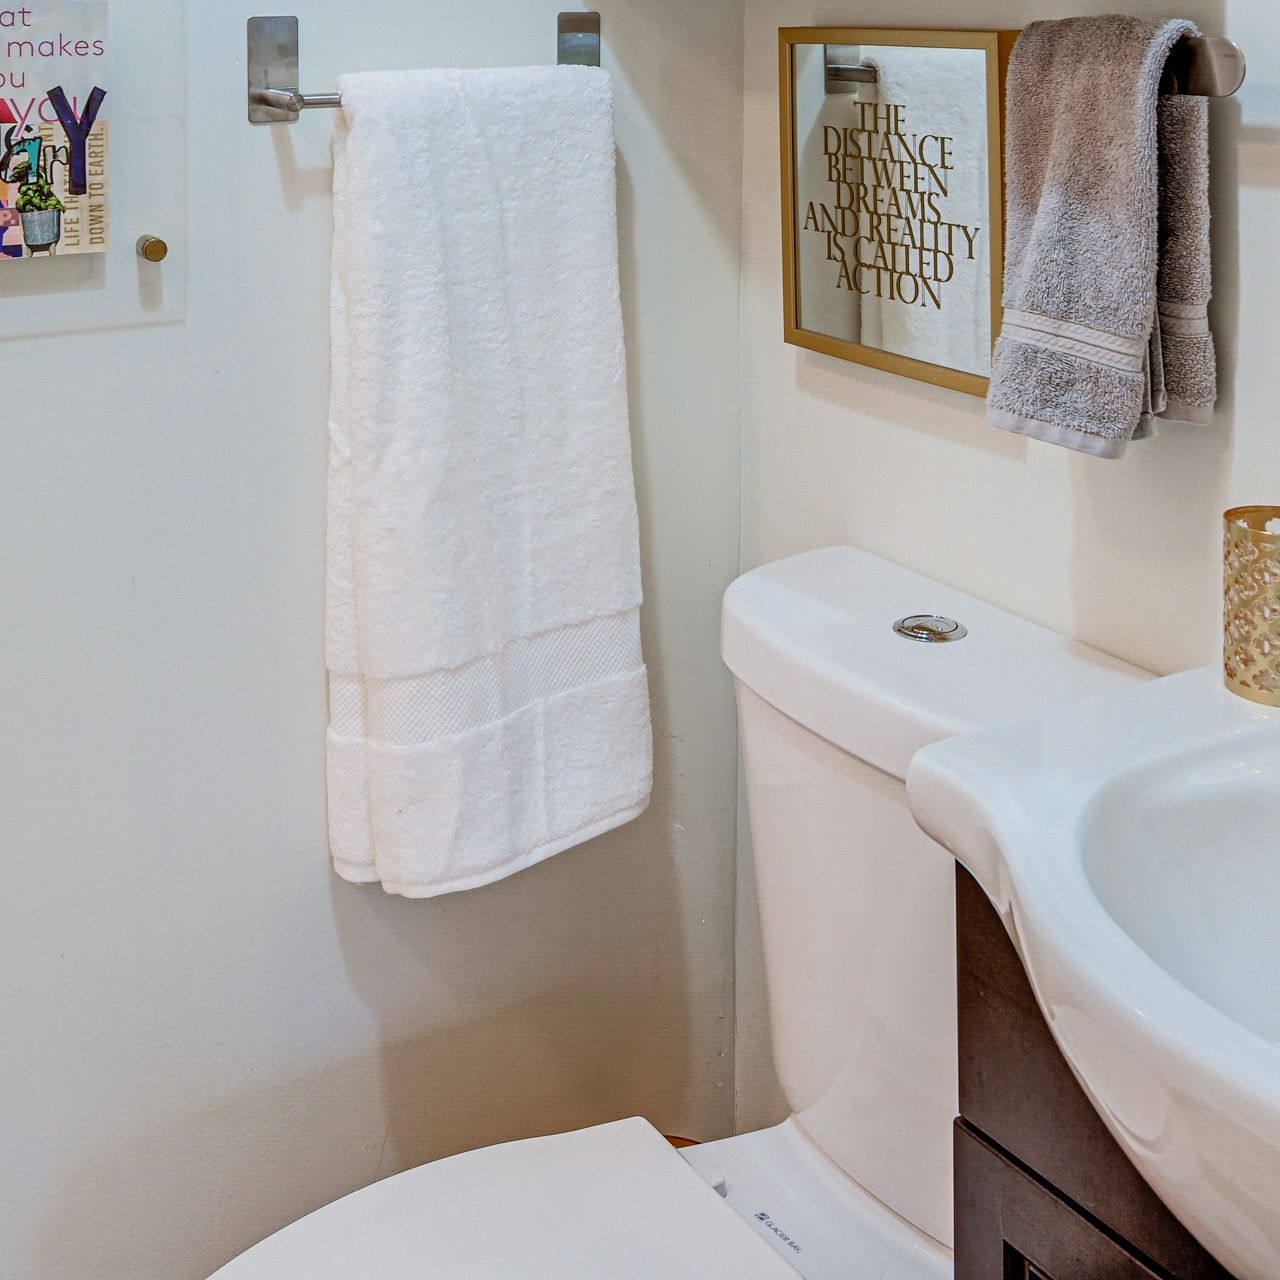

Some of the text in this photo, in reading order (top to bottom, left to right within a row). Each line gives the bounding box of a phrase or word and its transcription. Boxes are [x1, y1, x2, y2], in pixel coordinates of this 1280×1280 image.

[7, 33, 105, 58] makes
[853, 101, 906, 136] THE
[822, 125, 954, 170] DISTANCE
[88, 127, 105, 245] DOWN TO EARTH.
[826, 152, 948, 198] BETWEEN
[834, 179, 942, 225] DREAMS
[63, 217, 80, 247] LIFE
[803, 201, 982, 260] AND REALITY
[826, 230, 955, 283] IS CALLED
[836, 256, 942, 310] ACTION
[765, 1220, 790, 1242] GLACIER
